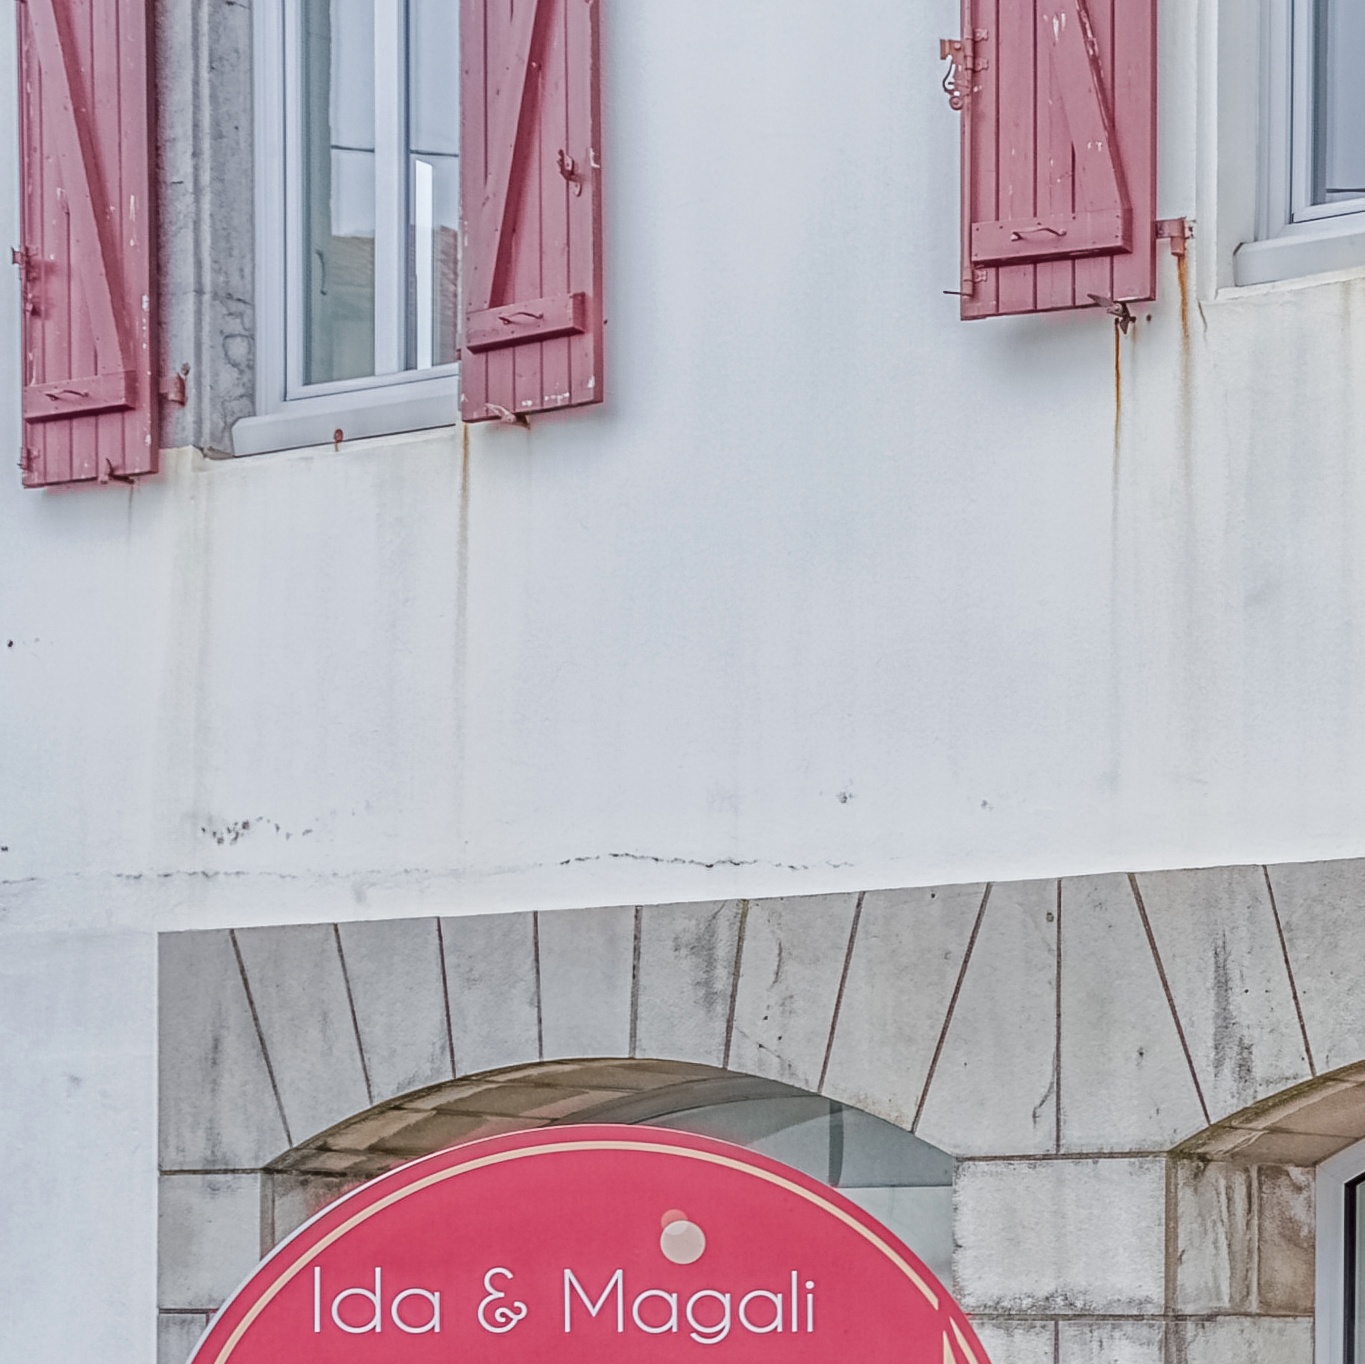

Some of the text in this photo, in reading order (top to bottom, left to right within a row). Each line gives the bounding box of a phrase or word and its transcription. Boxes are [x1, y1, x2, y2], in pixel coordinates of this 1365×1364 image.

[312, 1266, 816, 1345] Ida & Magali
